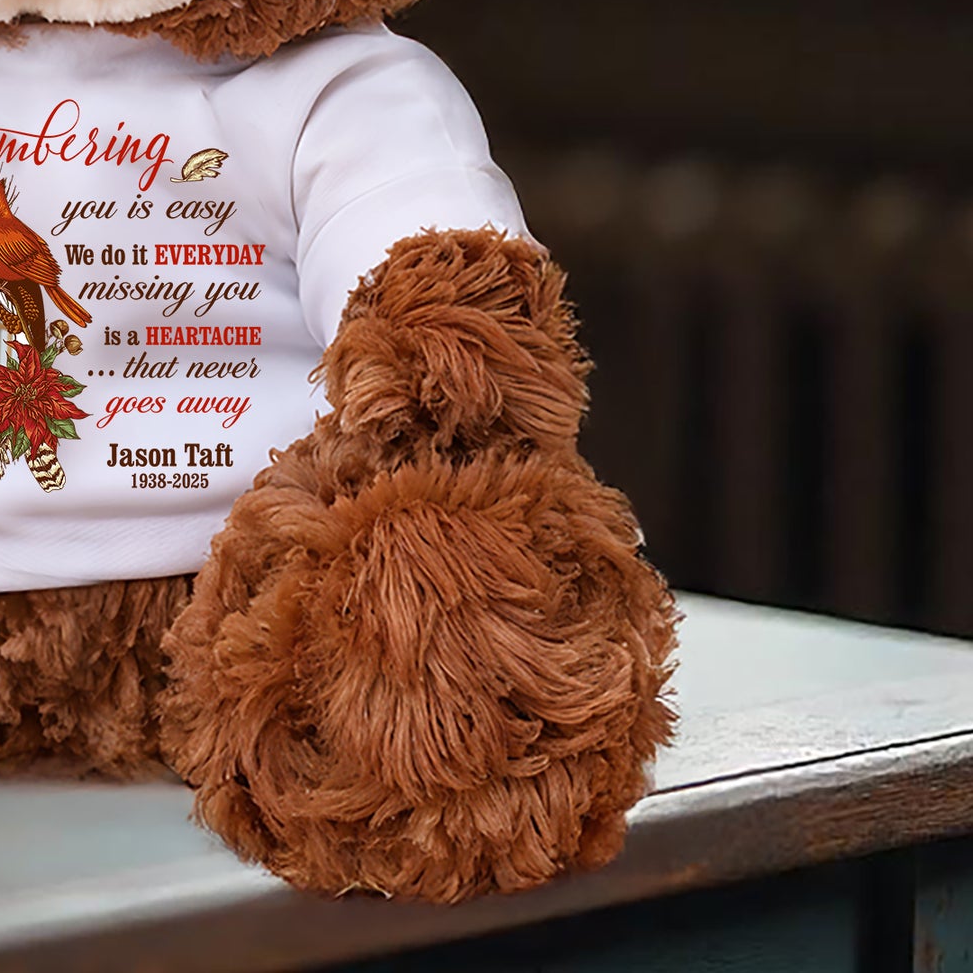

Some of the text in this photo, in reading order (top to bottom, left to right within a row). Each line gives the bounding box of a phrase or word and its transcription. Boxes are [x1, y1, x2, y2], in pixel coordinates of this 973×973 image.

[50, 193, 238, 237] you is easy
[63, 243, 266, 266] We do it EVERYDAY
[77, 274, 262, 318] missing you
[103, 325, 263, 347] is a HEARTACHE
[185, 356, 262, 379] never
[95, 396, 252, 429] goes away
[106, 442, 234, 468] Jason Taft
[131, 472, 210, 489] 1938-2025
